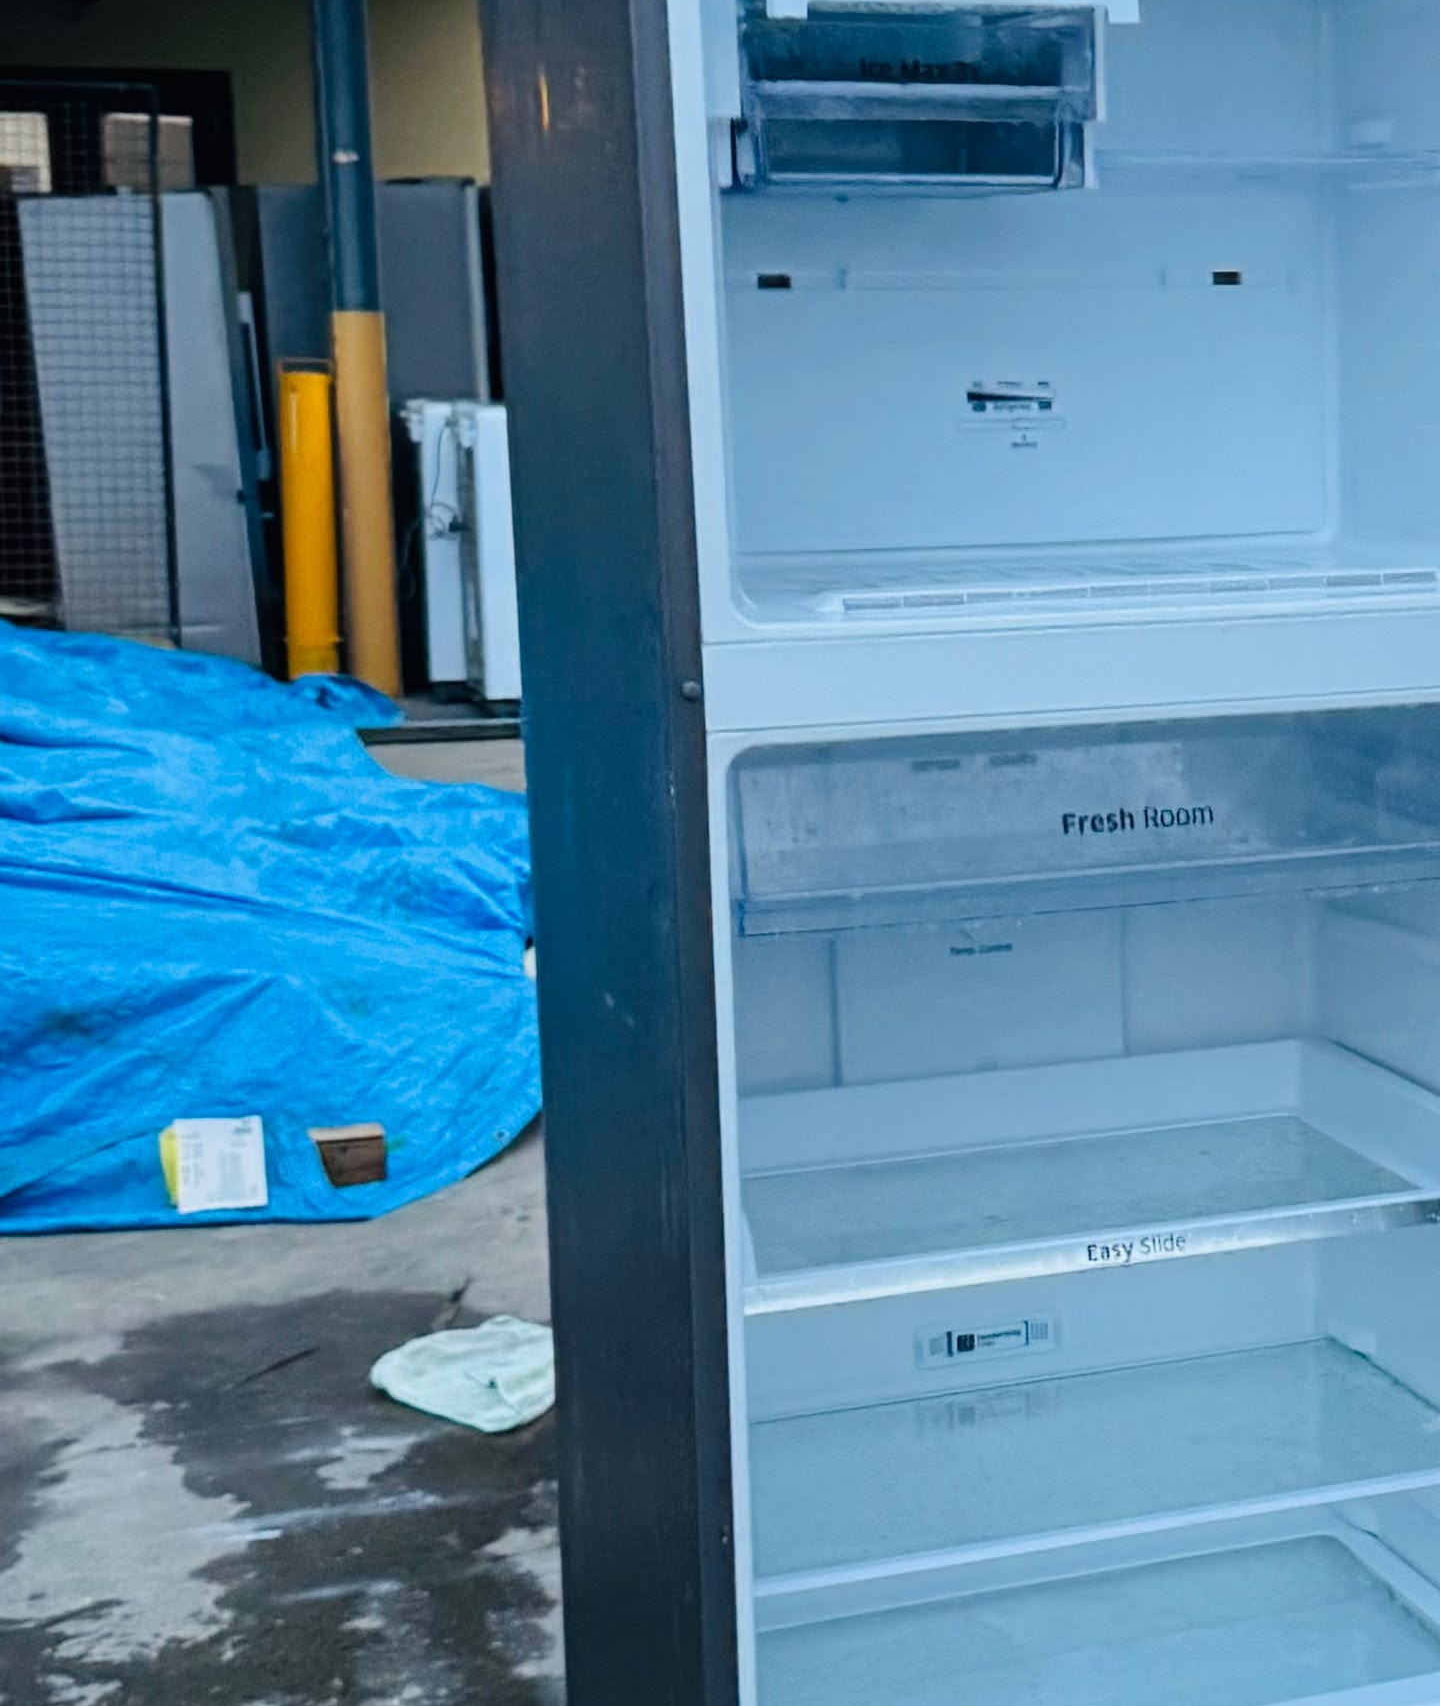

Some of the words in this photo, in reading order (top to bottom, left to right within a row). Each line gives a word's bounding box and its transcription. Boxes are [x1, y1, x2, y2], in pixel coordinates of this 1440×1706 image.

[1062, 807, 1135, 836] Fresh
[1144, 805, 1214, 829] Room
[1087, 1242, 1133, 1263] Easy
[1140, 1233, 1186, 1254] Slide
